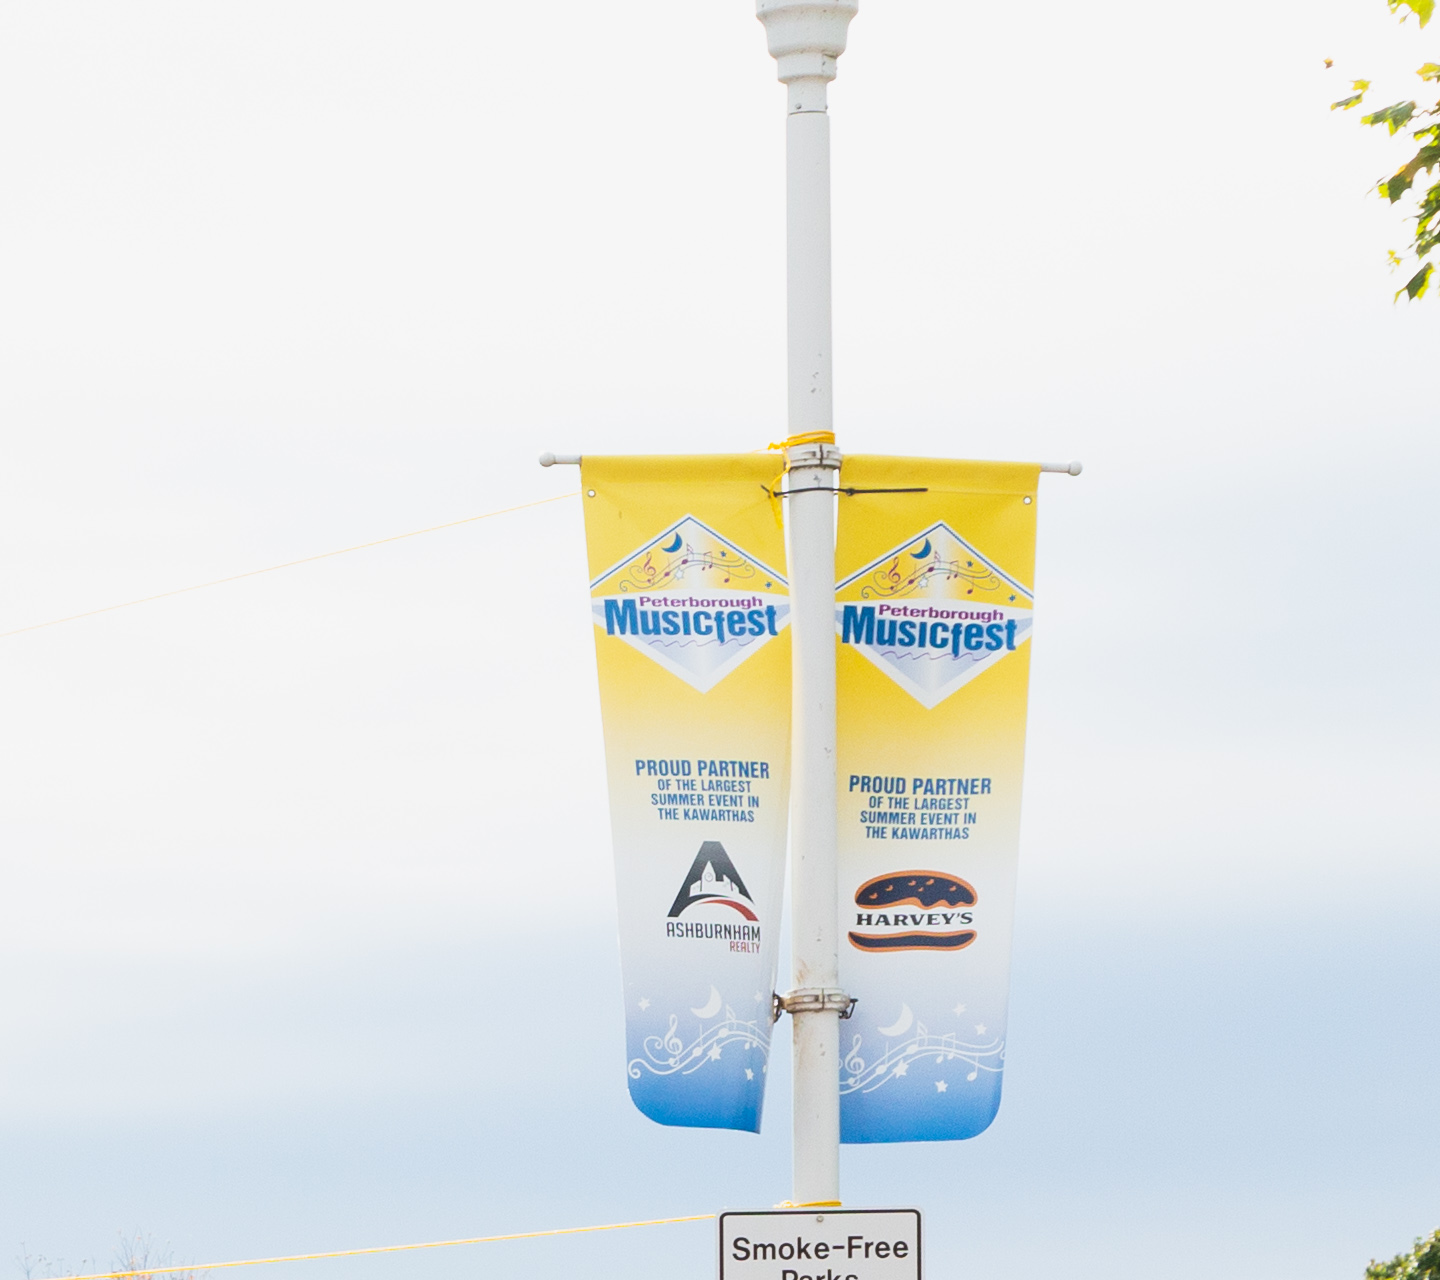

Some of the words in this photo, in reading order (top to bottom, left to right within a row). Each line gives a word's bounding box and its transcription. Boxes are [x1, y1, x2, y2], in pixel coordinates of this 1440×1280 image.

[639, 596, 763, 609] Peterborough
[878, 603, 1003, 622] Peterborough
[604, 599, 778, 643] Musicfest
[841, 604, 1016, 658] Musicfest
[635, 760, 691, 776] PROUD
[698, 760, 770, 779] PARTNER
[658, 779, 672, 791] OF
[675, 779, 696, 791] THE
[701, 780, 751, 793] LARGEST
[849, 775, 906, 794] PROUD
[913, 778, 991, 795] PARTNER
[651, 794, 704, 806] SUMMER
[709, 795, 743, 807] EVENT
[748, 796, 759, 807] IN
[869, 796, 883, 808] OF
[888, 797, 909, 809] THE
[915, 798, 970, 810] LARGEST
[658, 808, 679, 820] THE
[684, 808, 754, 822] KAWARTHAS
[860, 811, 915, 824] SUMMER
[921, 813, 959, 825] EVENT
[964, 812, 976, 824] IN
[865, 826, 887, 839] THE
[892, 827, 969, 839] KAWARTHAS
[856, 912, 973, 926] HARVEY'S
[666, 922, 760, 941] ASHBURNHAM
[730, 941, 760, 954] REALTY
[732, 1236, 909, 1261] Smoke-Free
